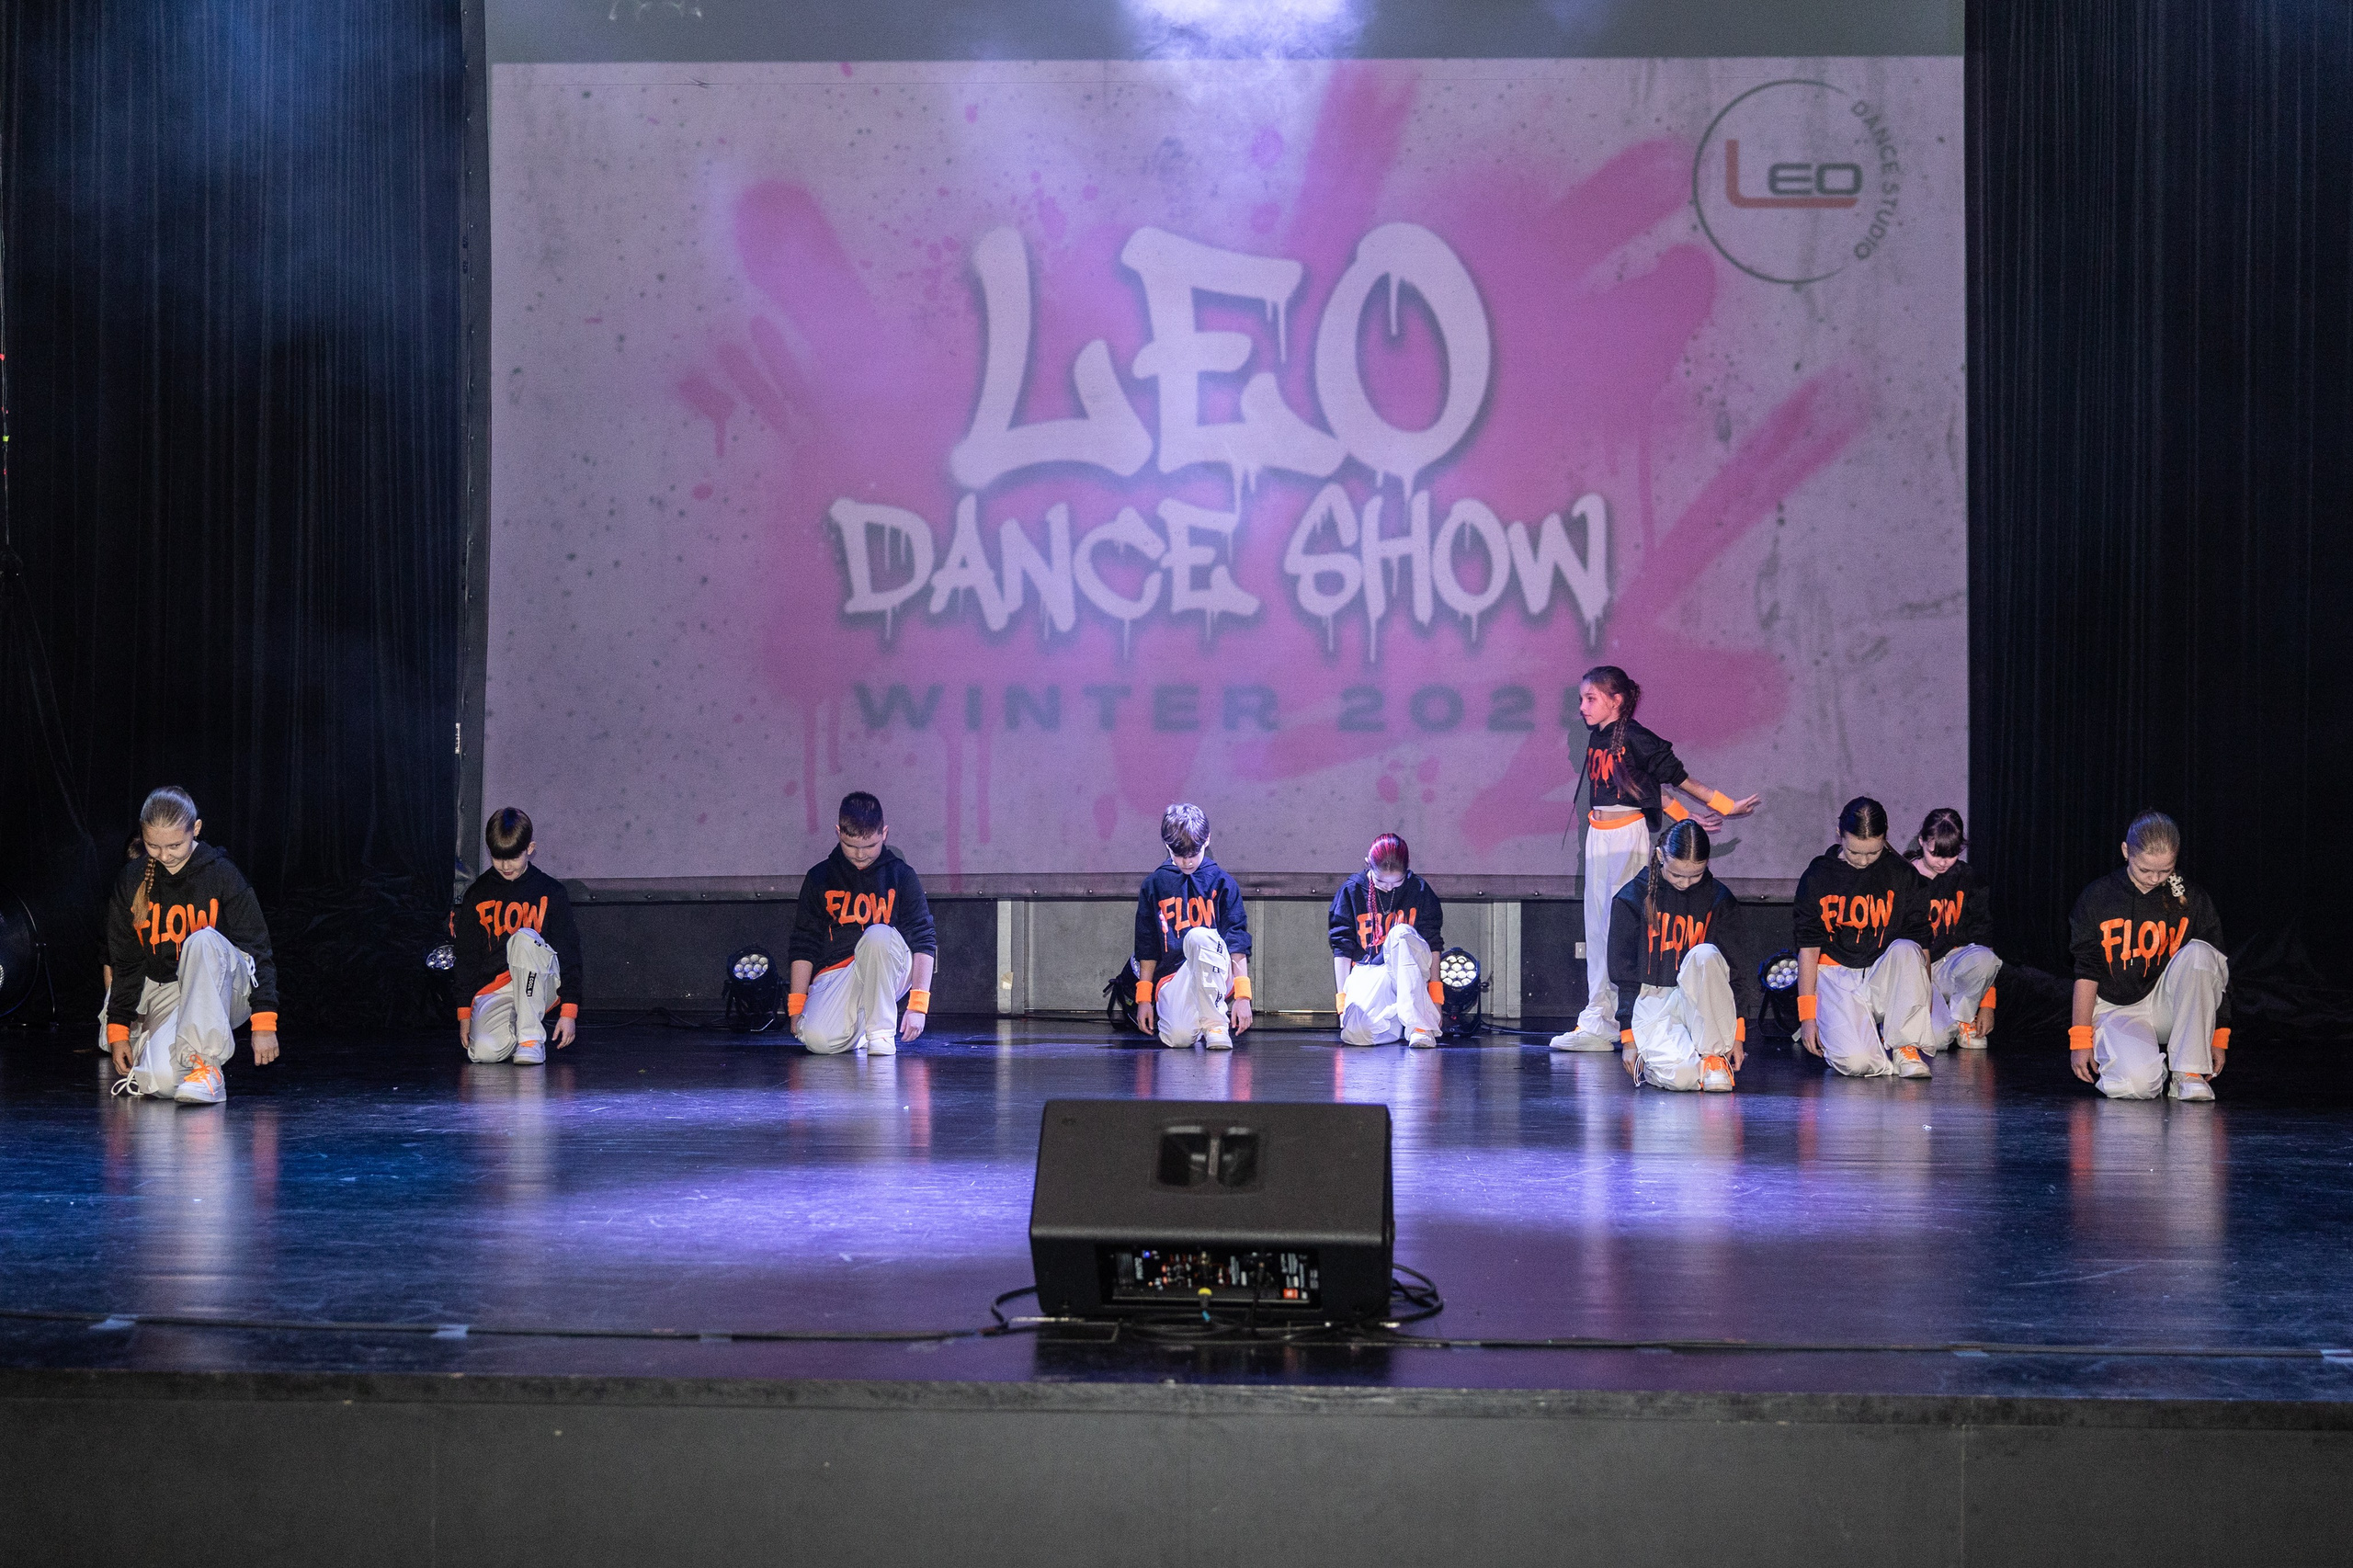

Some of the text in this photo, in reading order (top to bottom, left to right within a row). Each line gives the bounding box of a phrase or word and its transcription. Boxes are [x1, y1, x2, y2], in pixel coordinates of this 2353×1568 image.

[1725, 139, 1862, 209] LEO
[1850, 99, 1901, 261] DANCE STUDIO
[949, 222, 1493, 501] LEO
[829, 483, 1610, 660] DANCE SHOW
[853, 683, 1279, 732] WINTER
[475, 896, 549, 952] FLOW
[824, 888, 895, 941] FLOW
[1158, 890, 1218, 952] FLOW
[1819, 890, 1894, 949] FLOW
[2100, 916, 2189, 977] FLOW
